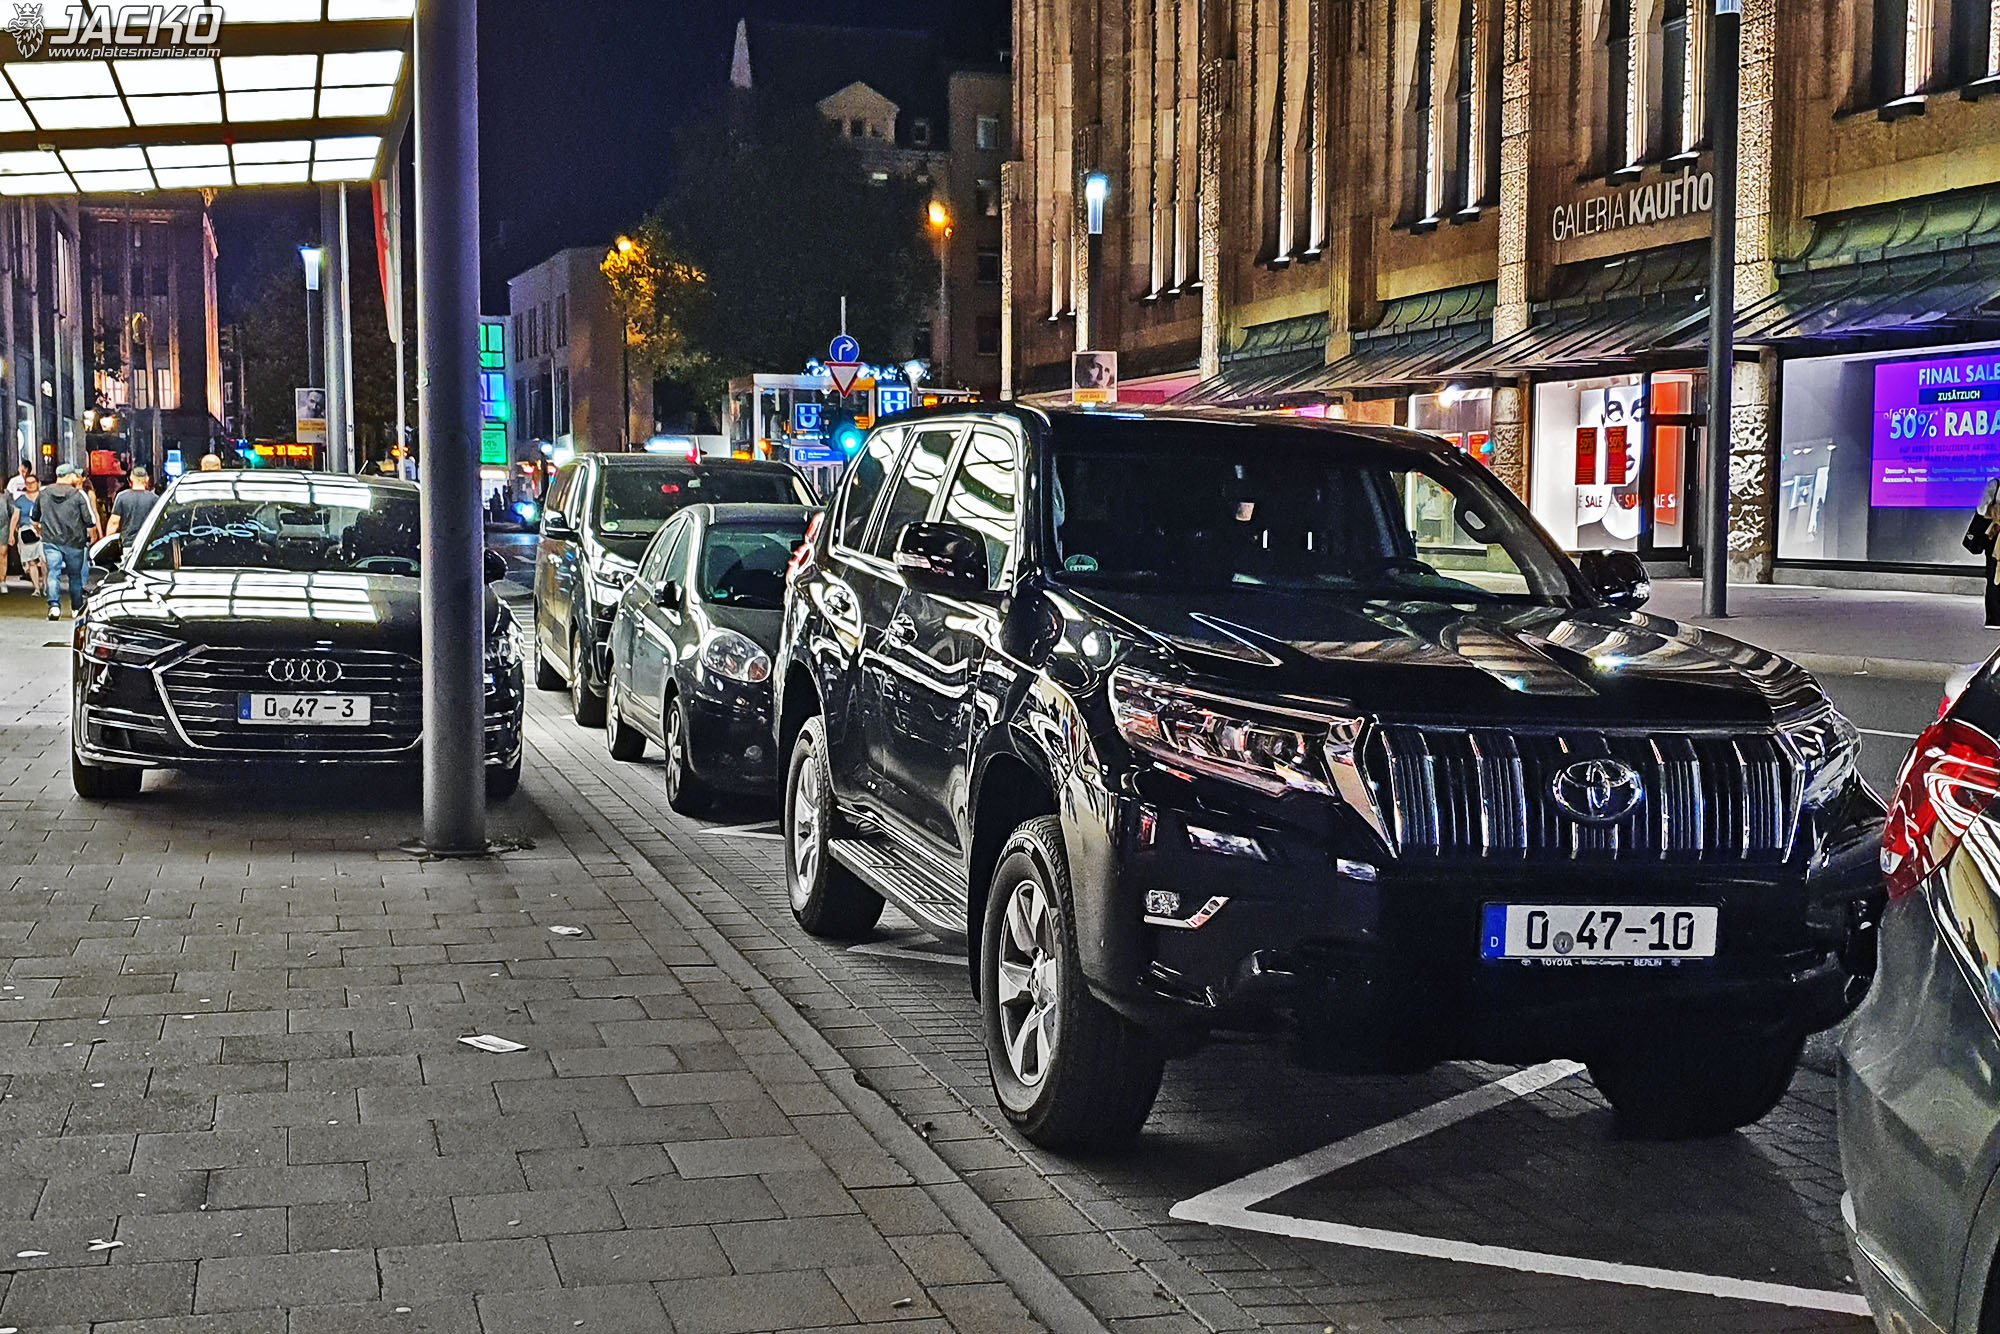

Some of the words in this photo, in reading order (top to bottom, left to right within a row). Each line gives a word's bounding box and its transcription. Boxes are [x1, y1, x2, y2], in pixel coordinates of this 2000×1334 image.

[1552, 192, 1626, 242] GALERIA
[1628, 165, 1714, 226] KAUFhO
[1918, 366, 1961, 386] FINAL
[1890, 413, 1938, 439] 50%
[1944, 409, 2000, 437] RABA
[1585, 495, 1603, 508] SALE
[1576, 911, 1695, 950] 47-10
[1490, 936, 1499, 948] D
[1541, 958, 1573, 967] TOYOTA
